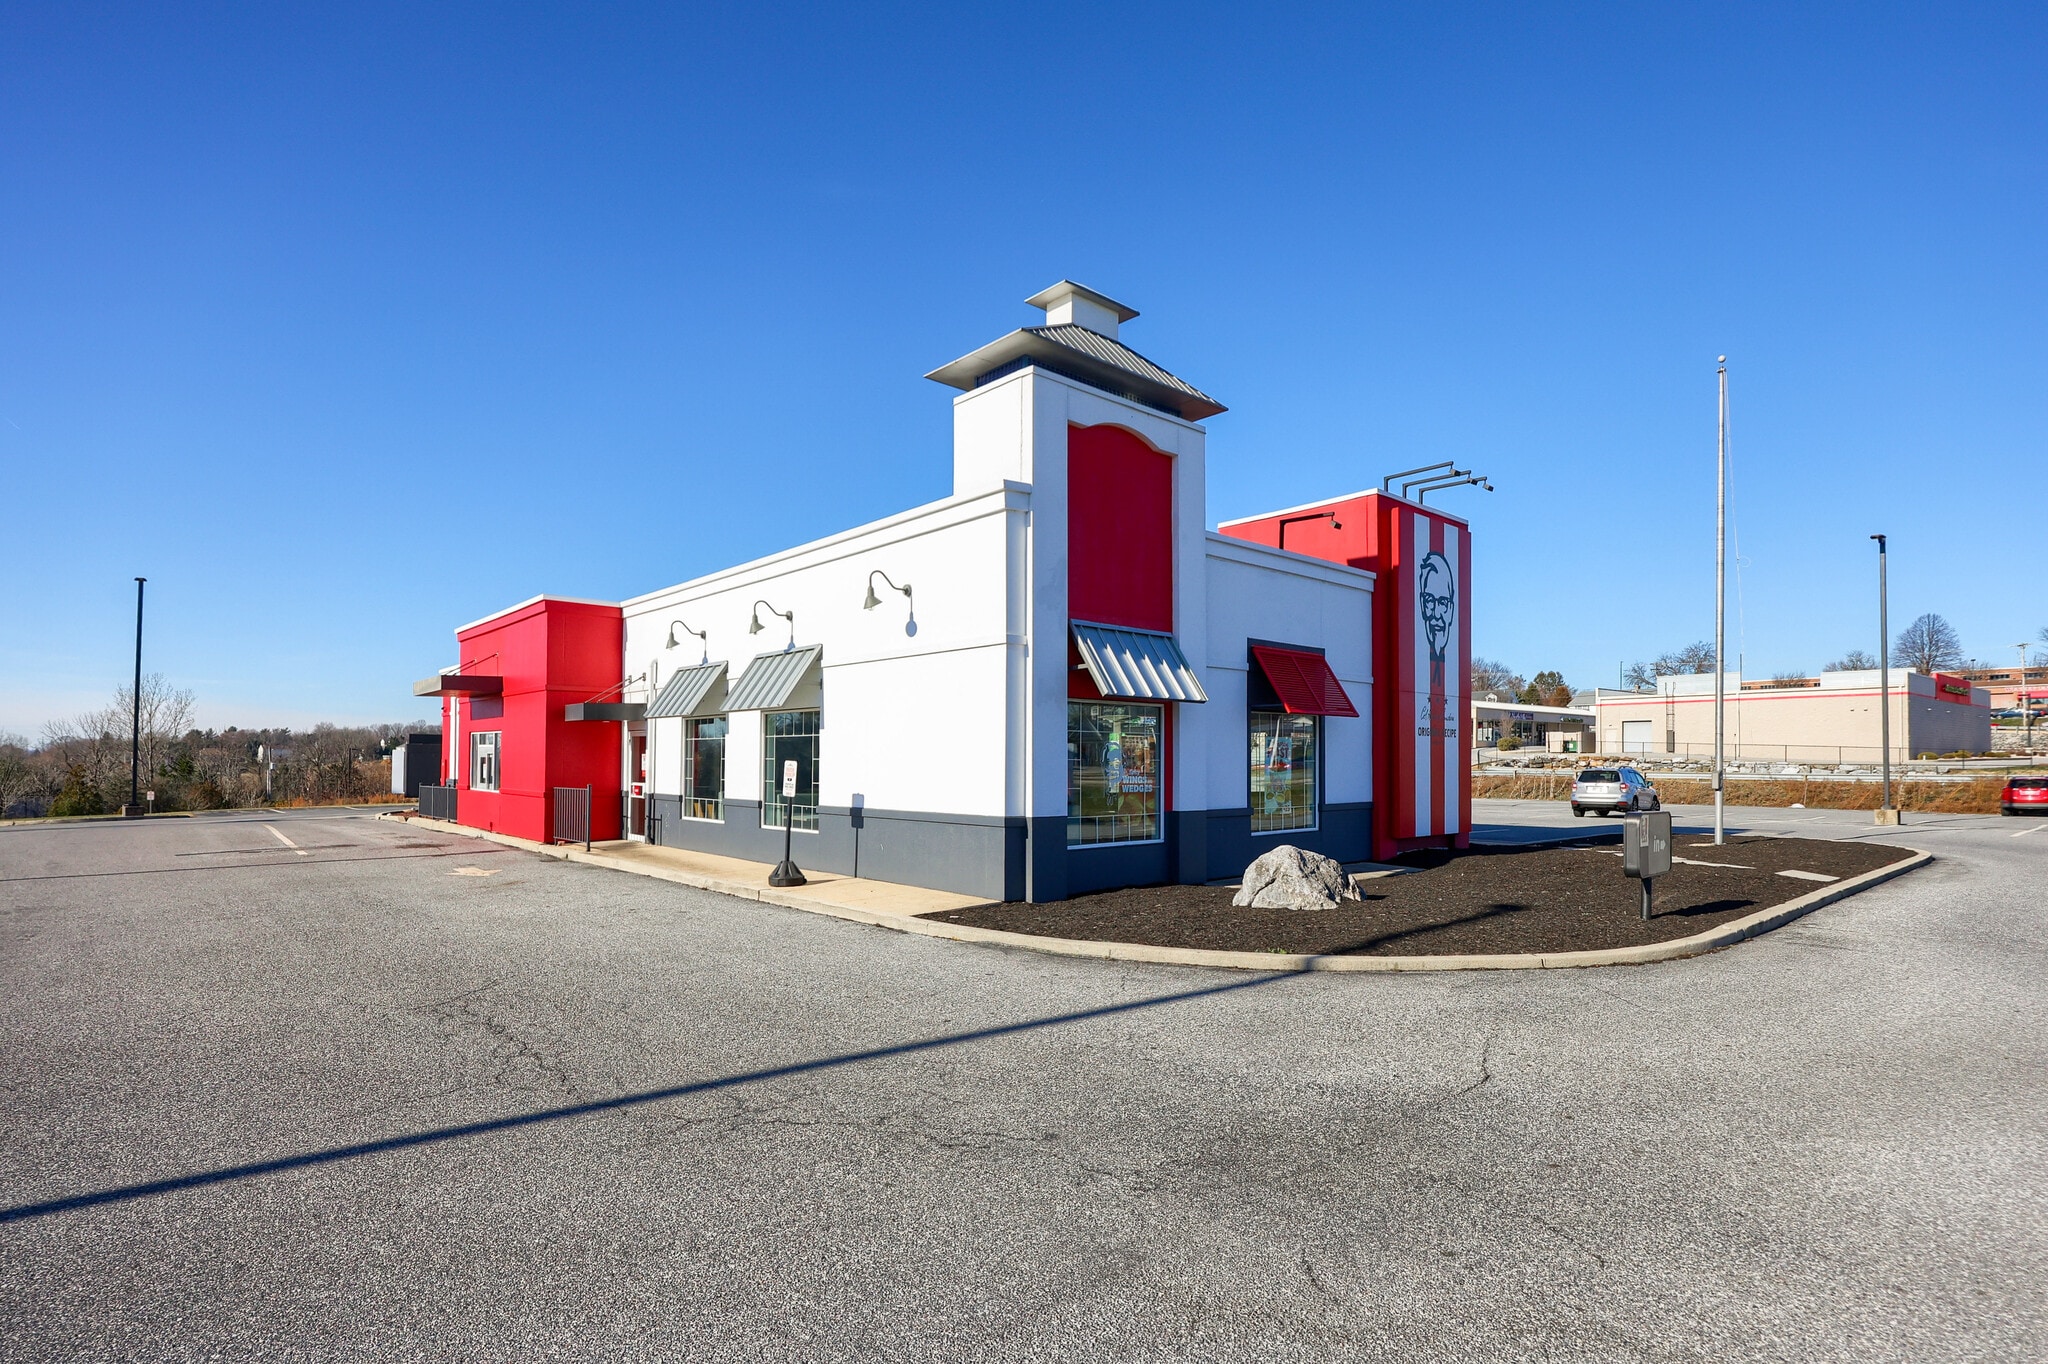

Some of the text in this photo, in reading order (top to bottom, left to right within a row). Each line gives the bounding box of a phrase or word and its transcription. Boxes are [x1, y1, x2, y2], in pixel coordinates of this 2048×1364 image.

[1442, 728, 1457, 738] ECIPE
[1122, 776, 1147, 784] WINGS
[1122, 785, 1153, 793] WEDGES
[1653, 835, 1660, 853] in
